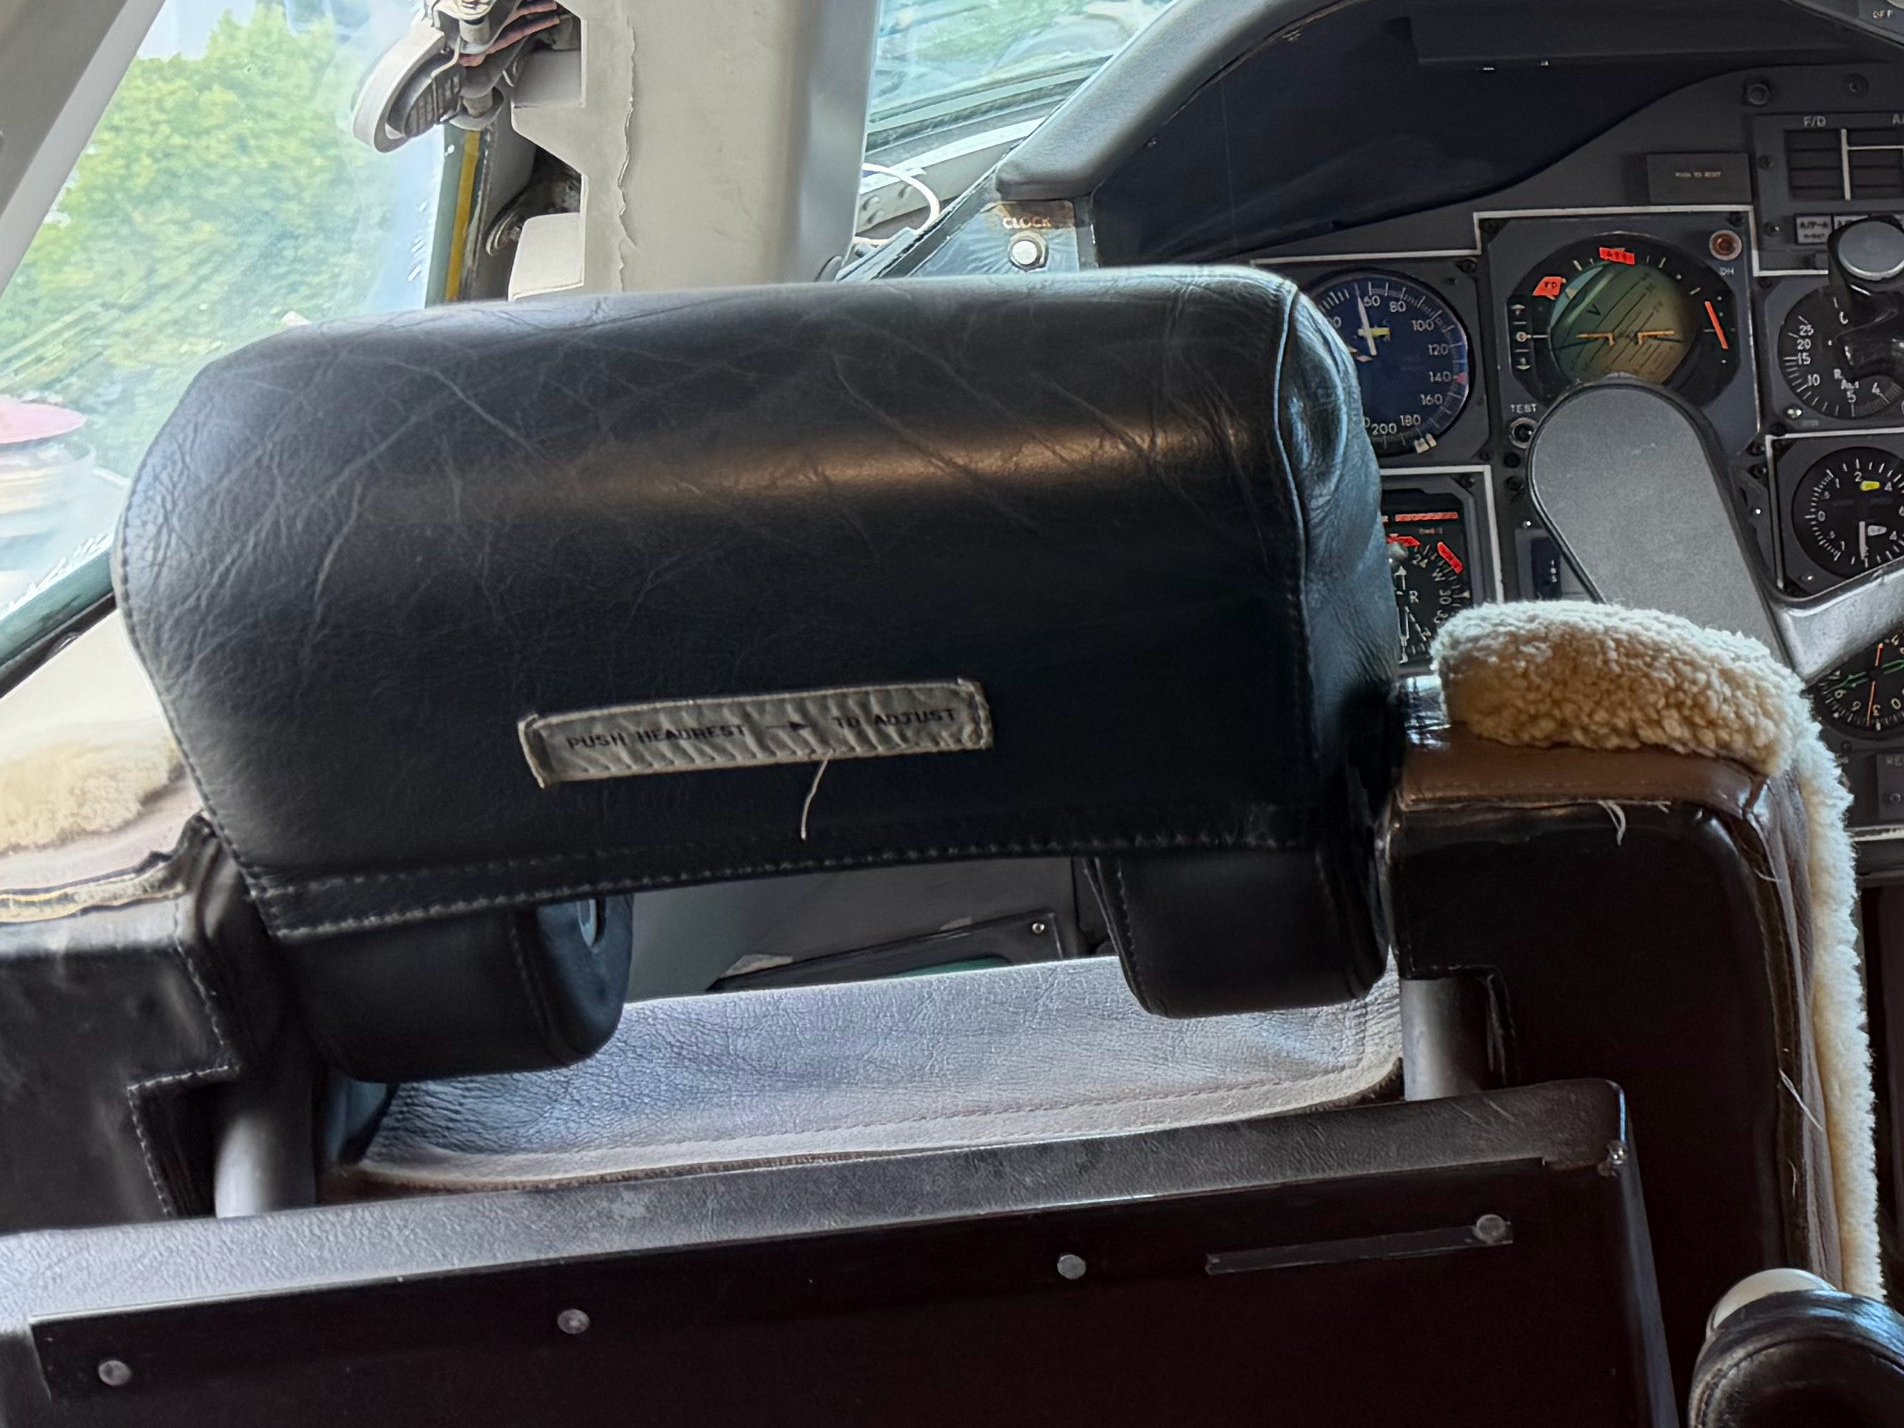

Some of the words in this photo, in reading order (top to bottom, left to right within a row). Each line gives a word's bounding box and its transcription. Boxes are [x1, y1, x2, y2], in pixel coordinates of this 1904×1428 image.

[1364, 296, 1380, 308] 60
[1389, 300, 1406, 312] 80
[1413, 319, 1434, 331] 100
[1429, 344, 1448, 355] 120
[1429, 371, 1451, 383] 140
[1422, 394, 1443, 406] 160
[1511, 404, 1538, 413] TEST
[1400, 414, 1421, 426] 180
[1371, 423, 1397, 434] 200
[567, 733, 626, 751] PUSH
[638, 723, 746, 744] HEADREST
[833, 715, 861, 730] TO
[874, 708, 958, 727] ADJUST
